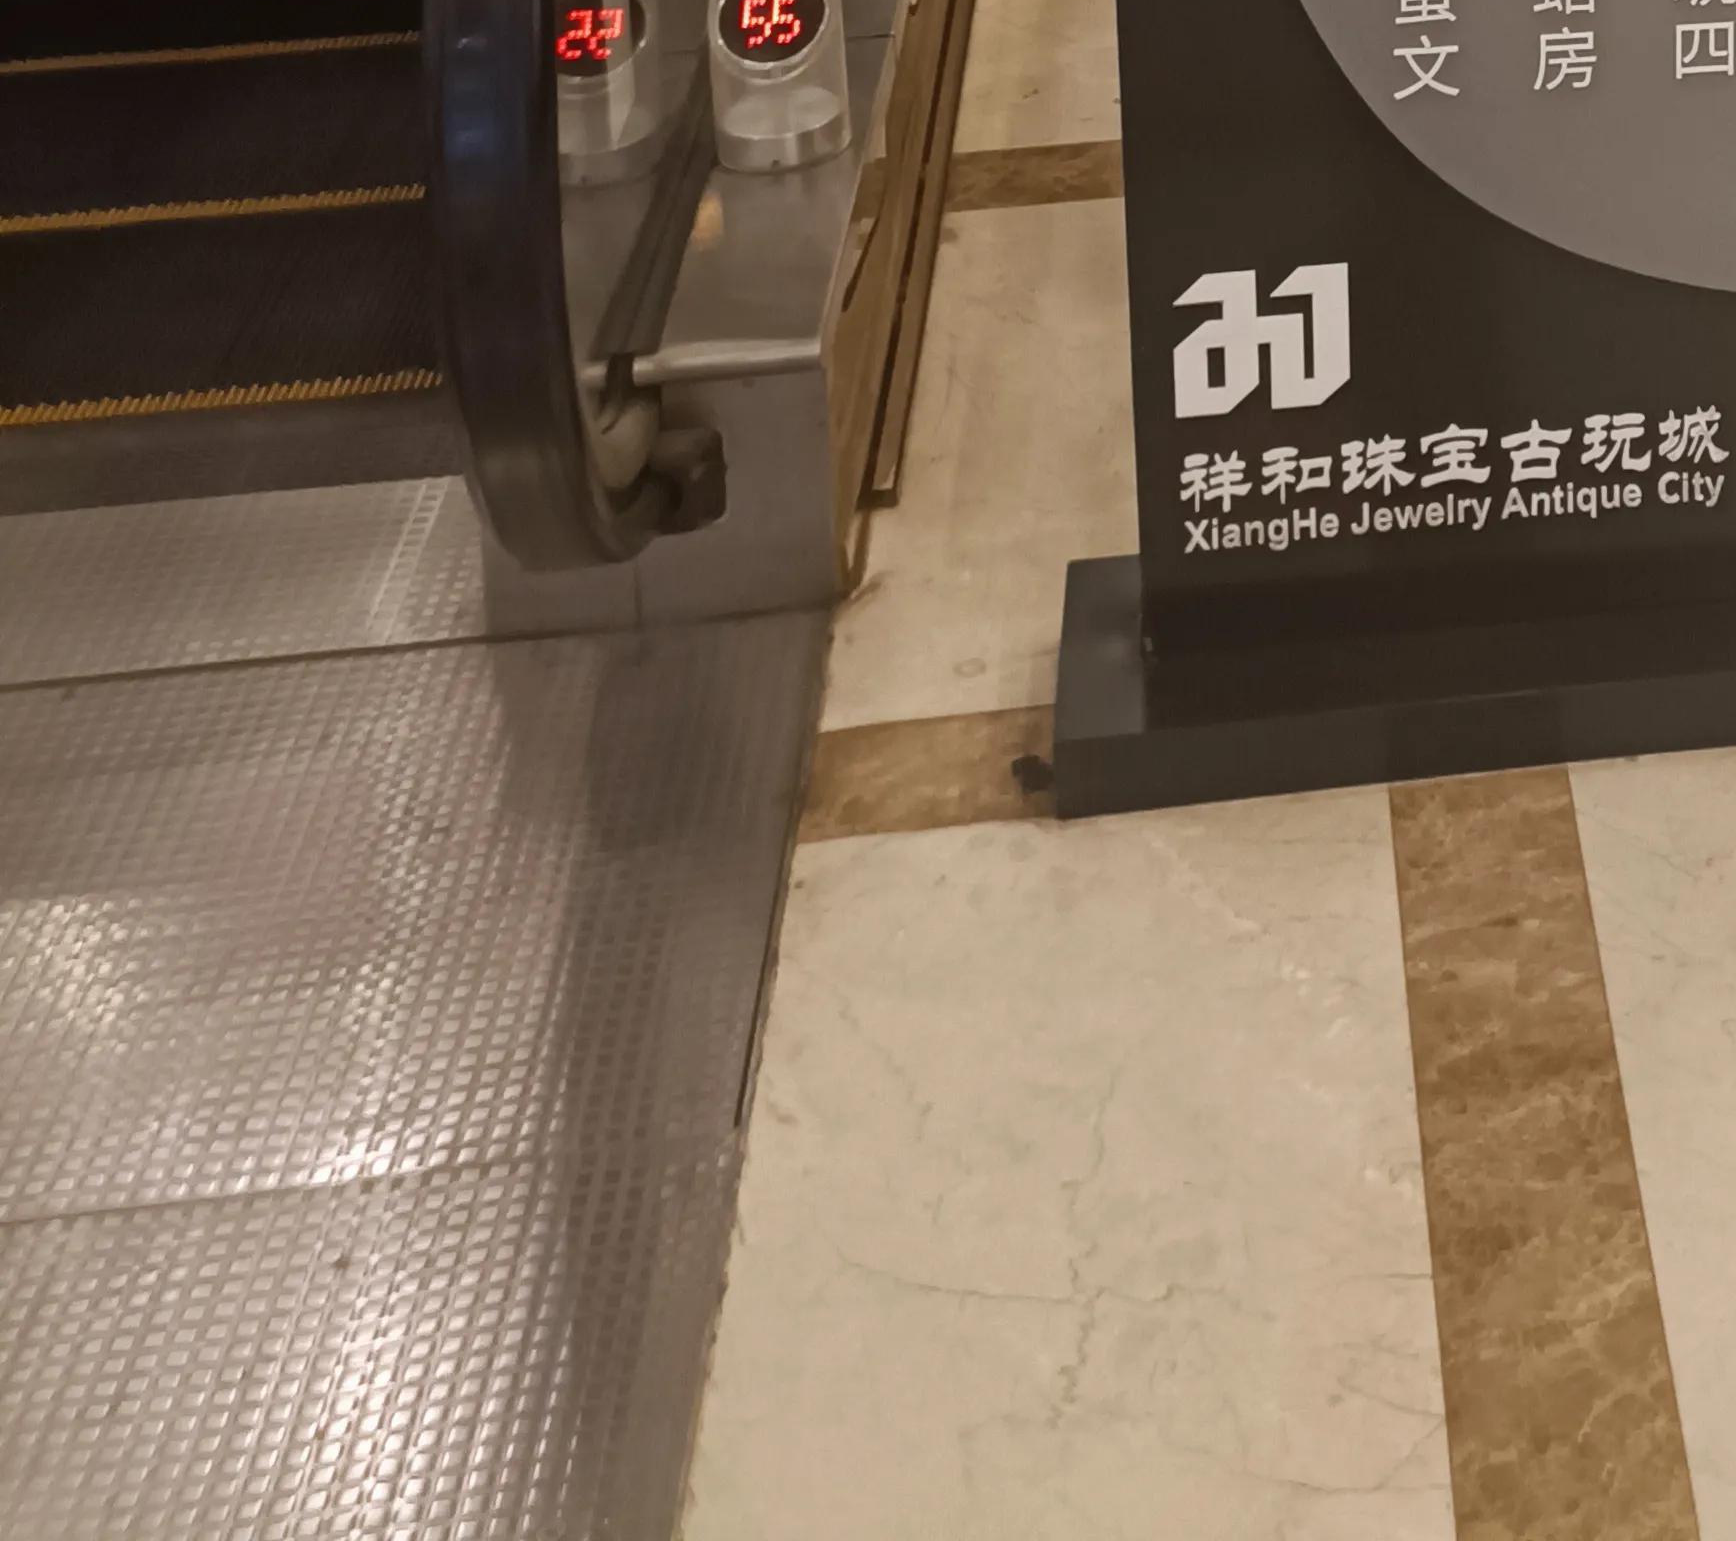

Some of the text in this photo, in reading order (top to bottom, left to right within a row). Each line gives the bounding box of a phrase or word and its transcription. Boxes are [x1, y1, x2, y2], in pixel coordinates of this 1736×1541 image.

[1180, 404, 1730, 514] 祥和珠宝古玩城
[1184, 470, 1725, 554] XiangHe Jewelry Antique City
